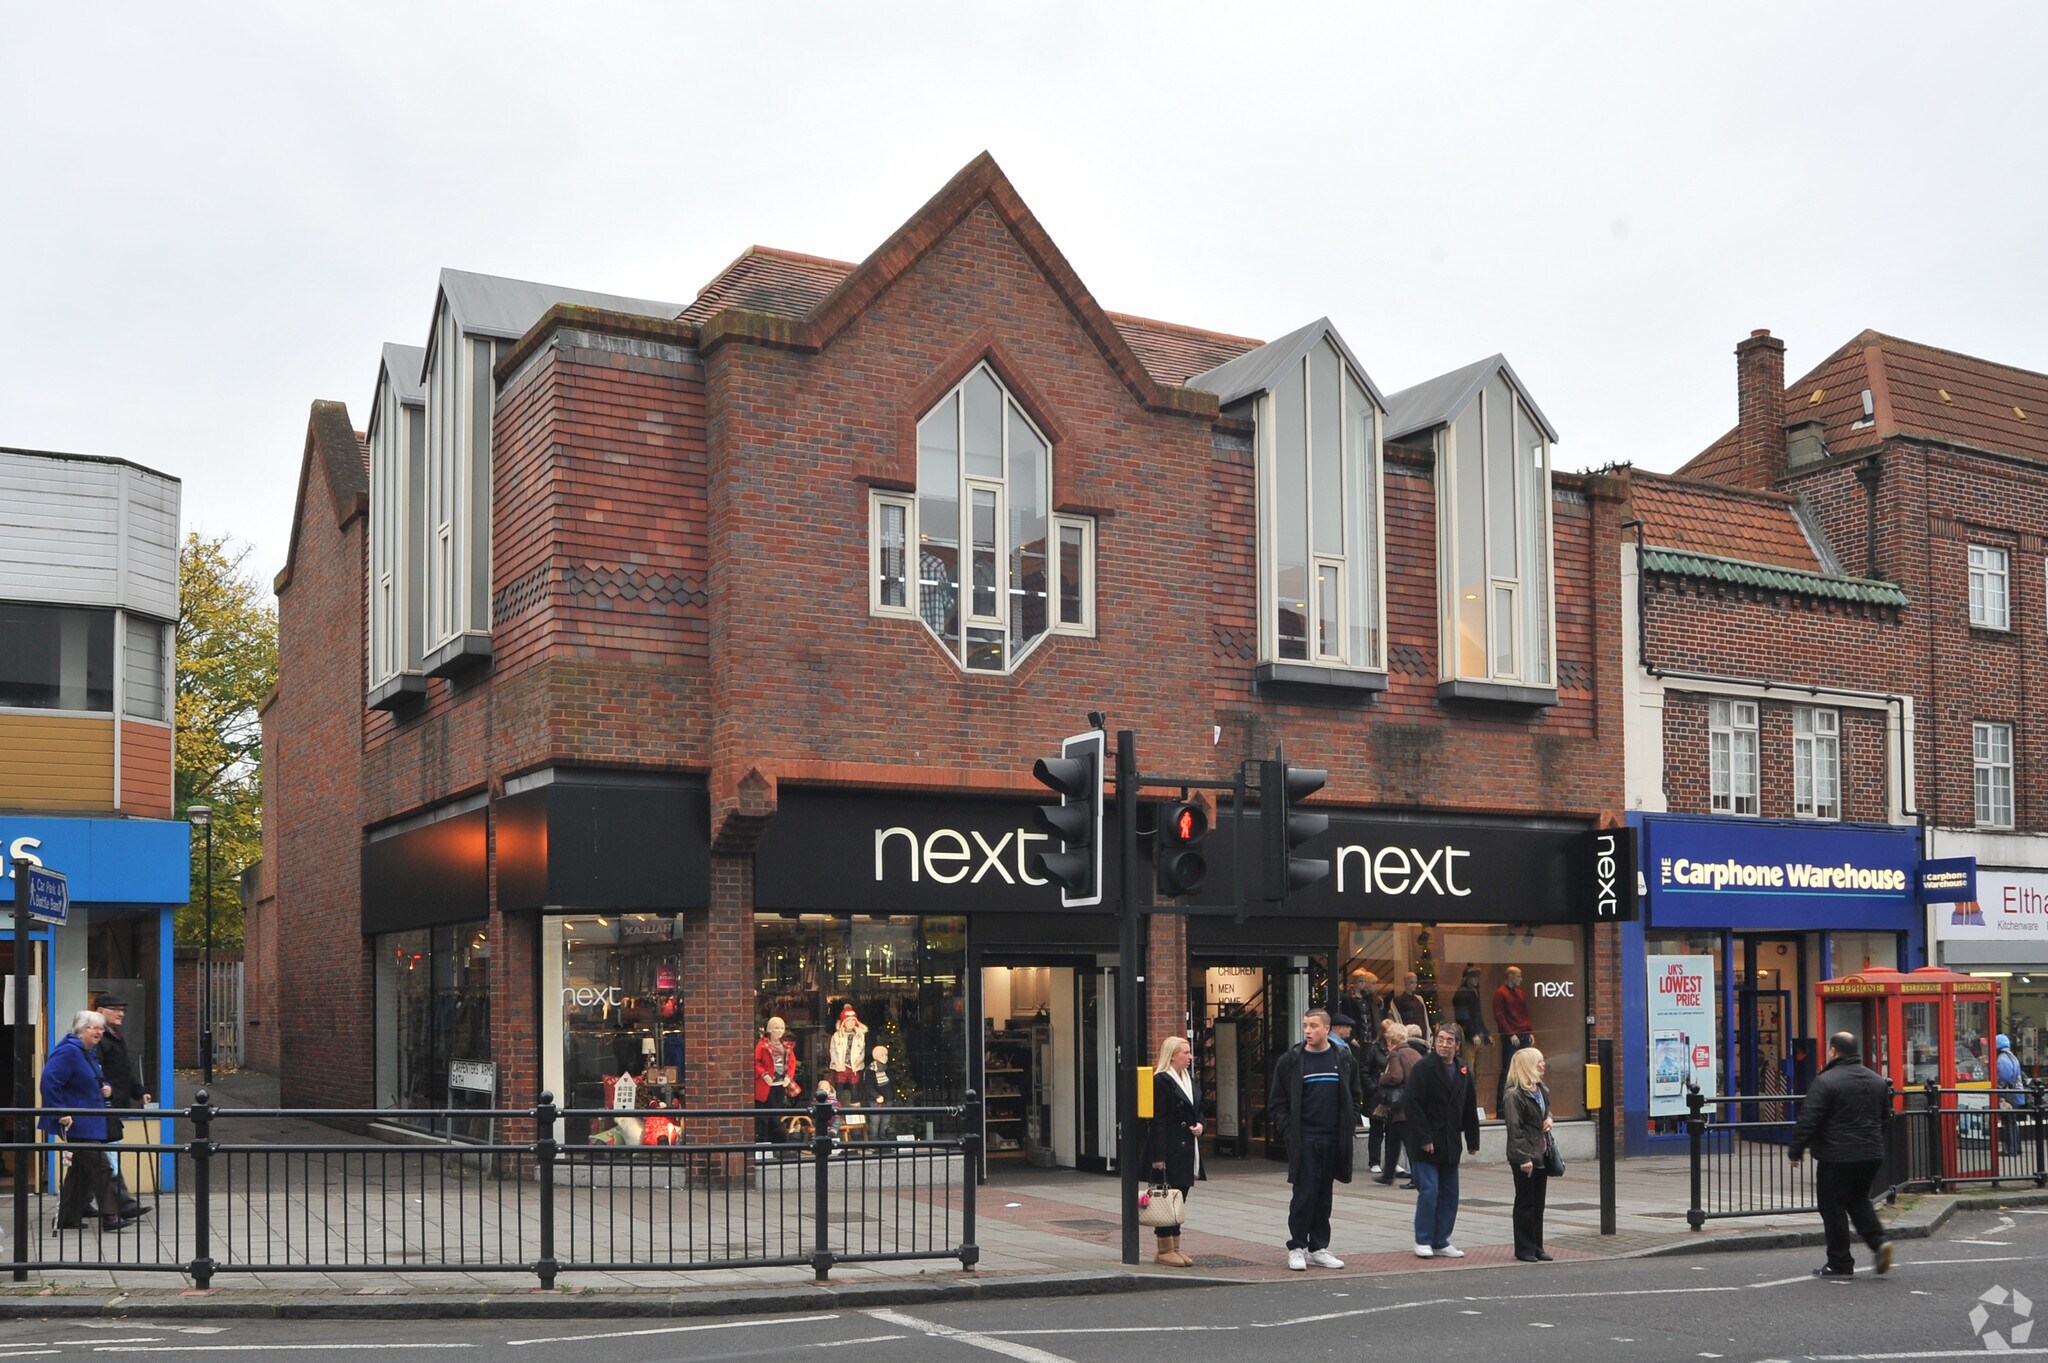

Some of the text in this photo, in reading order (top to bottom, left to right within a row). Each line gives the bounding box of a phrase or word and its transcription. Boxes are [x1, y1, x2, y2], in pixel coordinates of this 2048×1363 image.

[0, 837, 43, 879] S
[875, 827, 1049, 886] next
[1337, 845, 1472, 897] next
[1597, 835, 1617, 916] next
[1661, 857, 1906, 891] THE Carphone Warehouse
[1926, 871, 1968, 882] Carphone
[36, 878, 45, 892] Car
[46, 881, 57, 897] Park
[1923, 879, 1968, 889] Warehouse
[1998, 919, 2039, 931] Kitchenware
[1667, 963, 1684, 976] UK'S
[1218, 983, 1235, 994] MEN
[1534, 980, 1574, 998] next
[1659, 975, 1703, 994] LOWEST
[1827, 984, 1881, 993] TELEPHONE
[1903, 984, 1940, 993] TELEPHONE
[561, 986, 622, 1007] next
[1676, 993, 1701, 1007] PRICE
[452, 1060, 479, 1075] CARPENTERS
[452, 1074, 464, 1085] PATH
